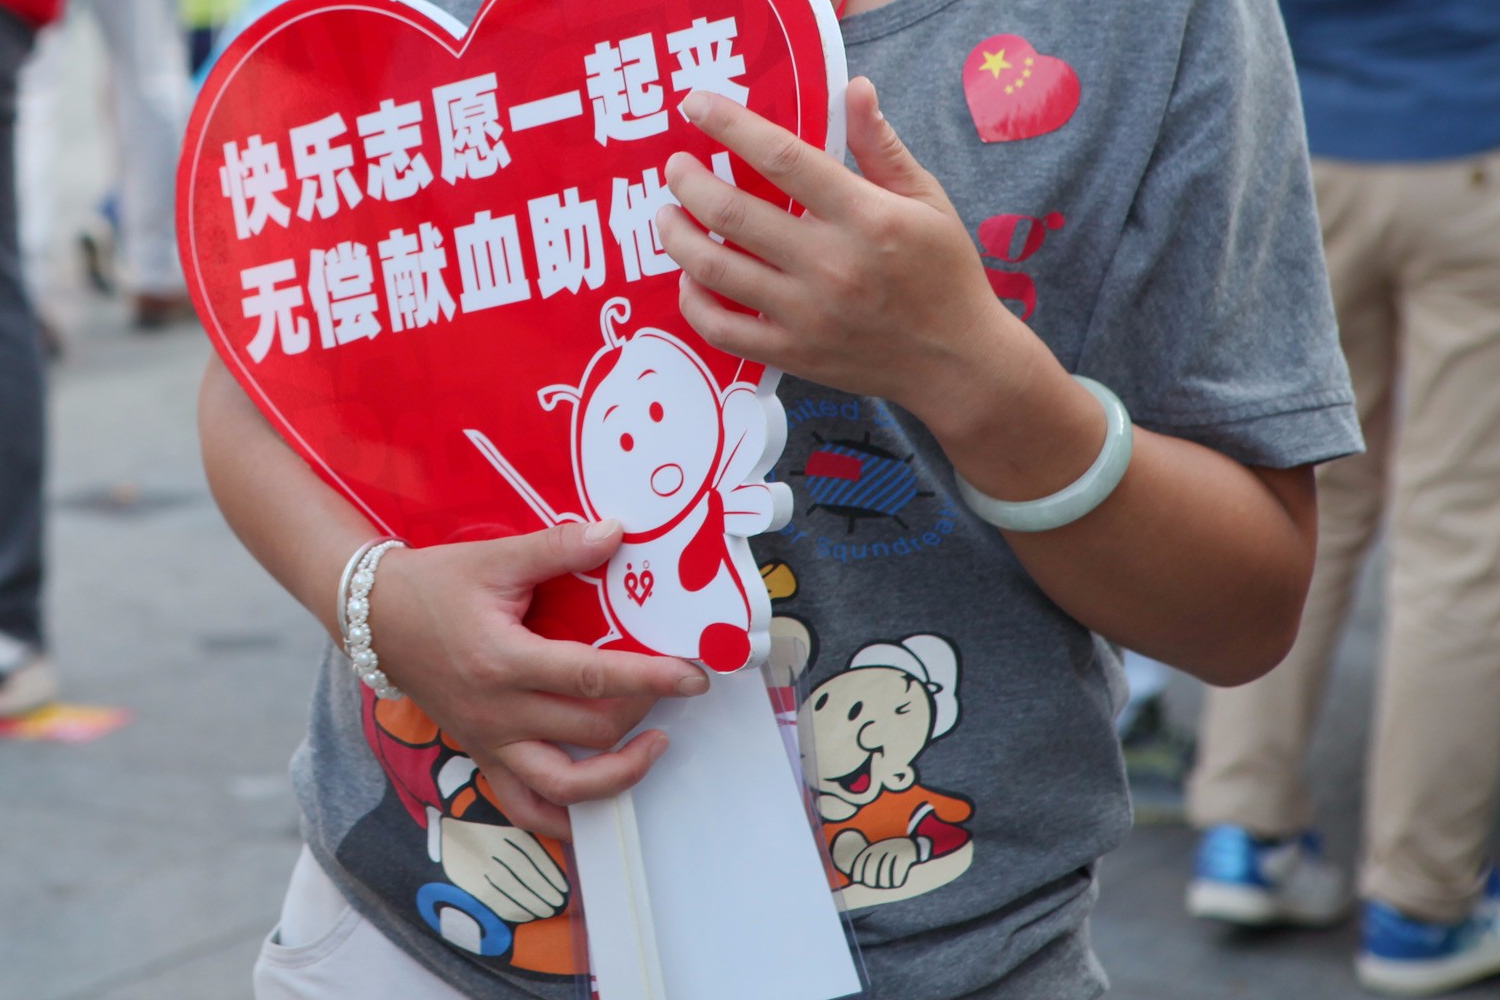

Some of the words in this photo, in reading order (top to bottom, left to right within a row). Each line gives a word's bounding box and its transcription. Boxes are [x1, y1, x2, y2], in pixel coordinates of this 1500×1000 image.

[218, 16, 750, 240] 快乐志愿一起来
[239, 151, 737, 363] 无偿献血助他
[786, 398, 860, 430] nited
